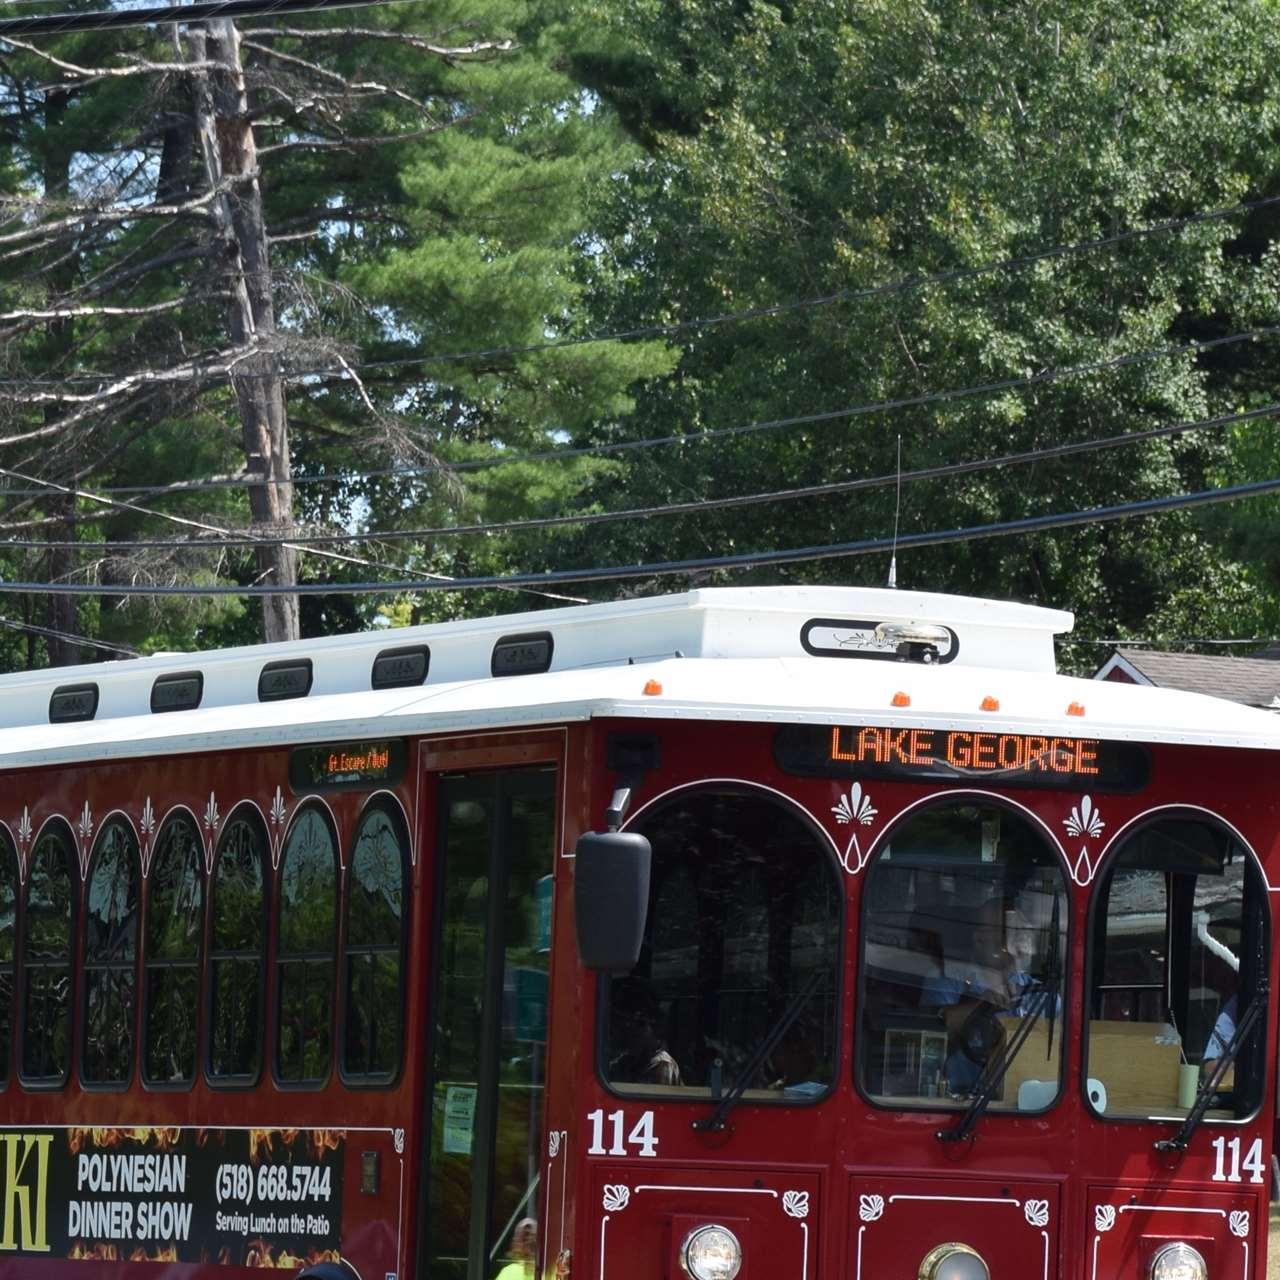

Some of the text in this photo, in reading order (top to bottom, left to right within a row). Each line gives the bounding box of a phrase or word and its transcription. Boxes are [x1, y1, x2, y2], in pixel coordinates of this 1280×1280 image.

[831, 727, 1099, 774] LAKE GEORGE
[587, 1108, 659, 1157] 114
[77, 1153, 187, 1193] POLYNESIAN
[1212, 1135, 1266, 1184] 114
[216, 1164, 331, 1206] (518) 668.5744
[68, 1200, 193, 1241] DINNER SHOW
[216, 1211, 330, 1236] Serving Lunch on the Patio
